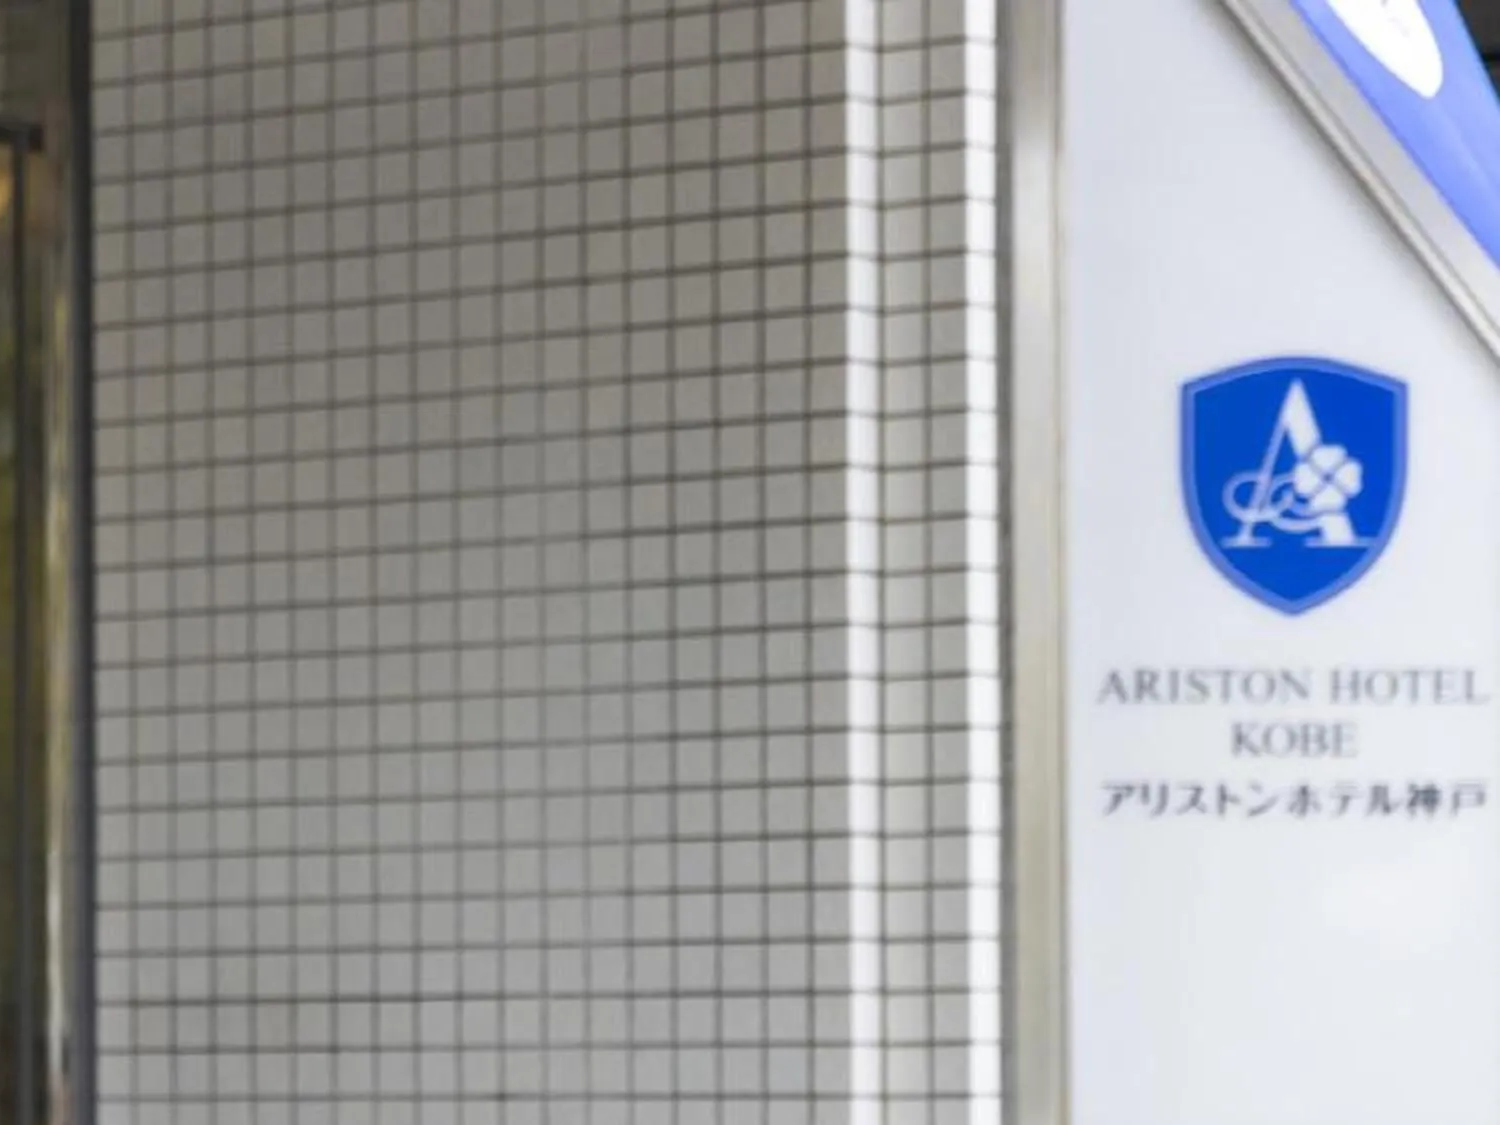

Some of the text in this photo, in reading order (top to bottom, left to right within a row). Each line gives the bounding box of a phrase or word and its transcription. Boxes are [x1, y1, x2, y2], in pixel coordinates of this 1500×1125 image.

[1098, 667, 1491, 705] ARISTON HOTEL
[1230, 720, 1359, 758] KOBE
[1100, 780, 1487, 819] アリストンホテル神戸
